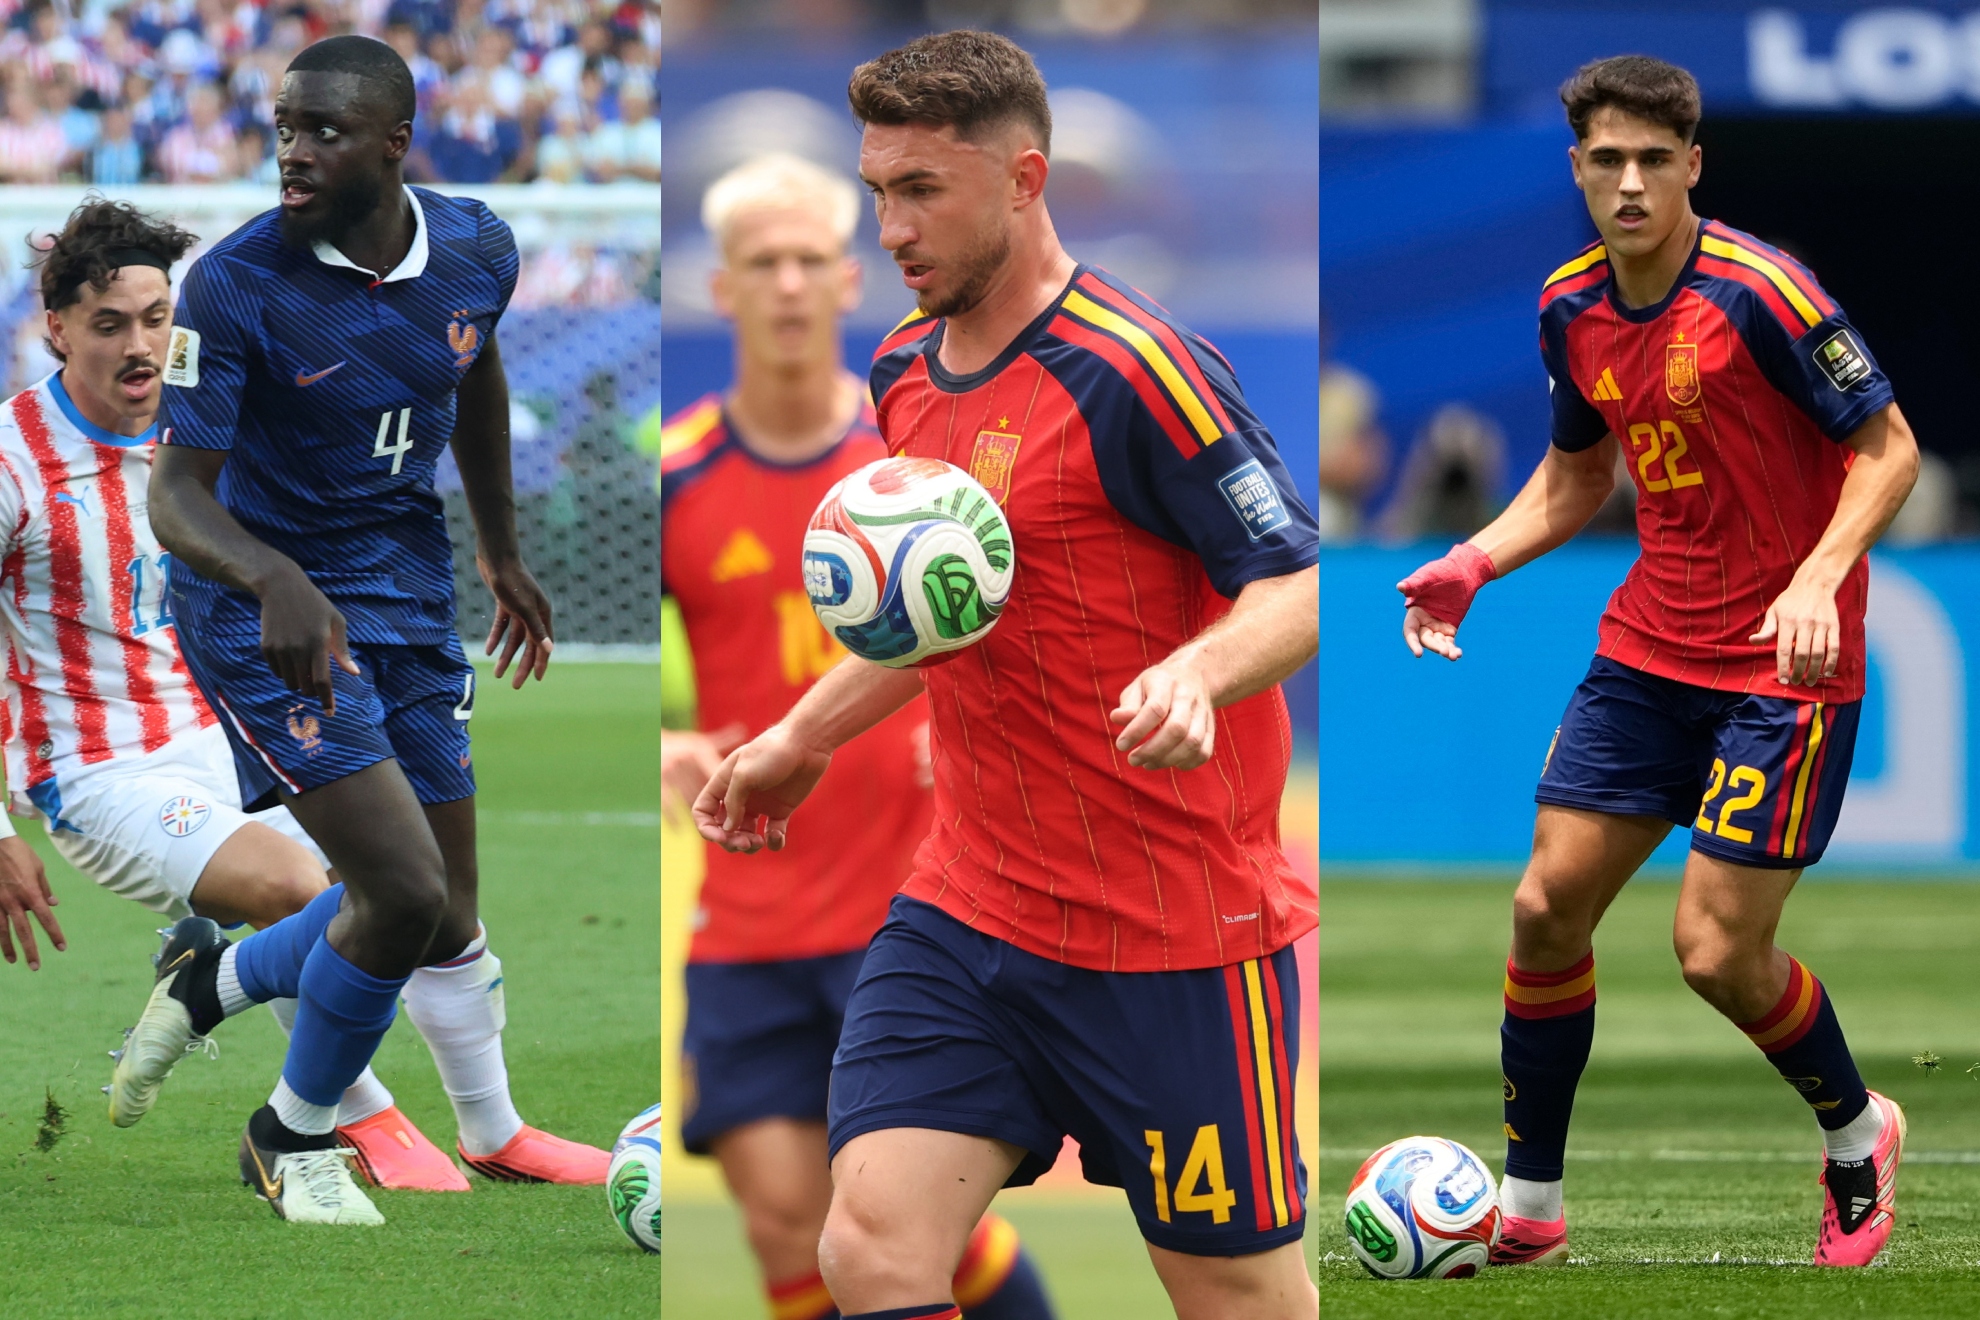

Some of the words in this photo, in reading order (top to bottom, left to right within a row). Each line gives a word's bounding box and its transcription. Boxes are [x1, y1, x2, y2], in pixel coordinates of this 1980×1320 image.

[1747, 8, 1980, 107] LO
[371, 407, 414, 476] 4
[1628, 420, 1704, 493] 22
[1228, 471, 1263, 497] FOOTBALL
[1234, 481, 1270, 509] UNITES
[1242, 508, 1256, 522] the
[1253, 494, 1278, 516] World
[1257, 512, 1275, 525] FIFA
[1695, 757, 1766, 844] 22
[1144, 1123, 1236, 1225] 14
